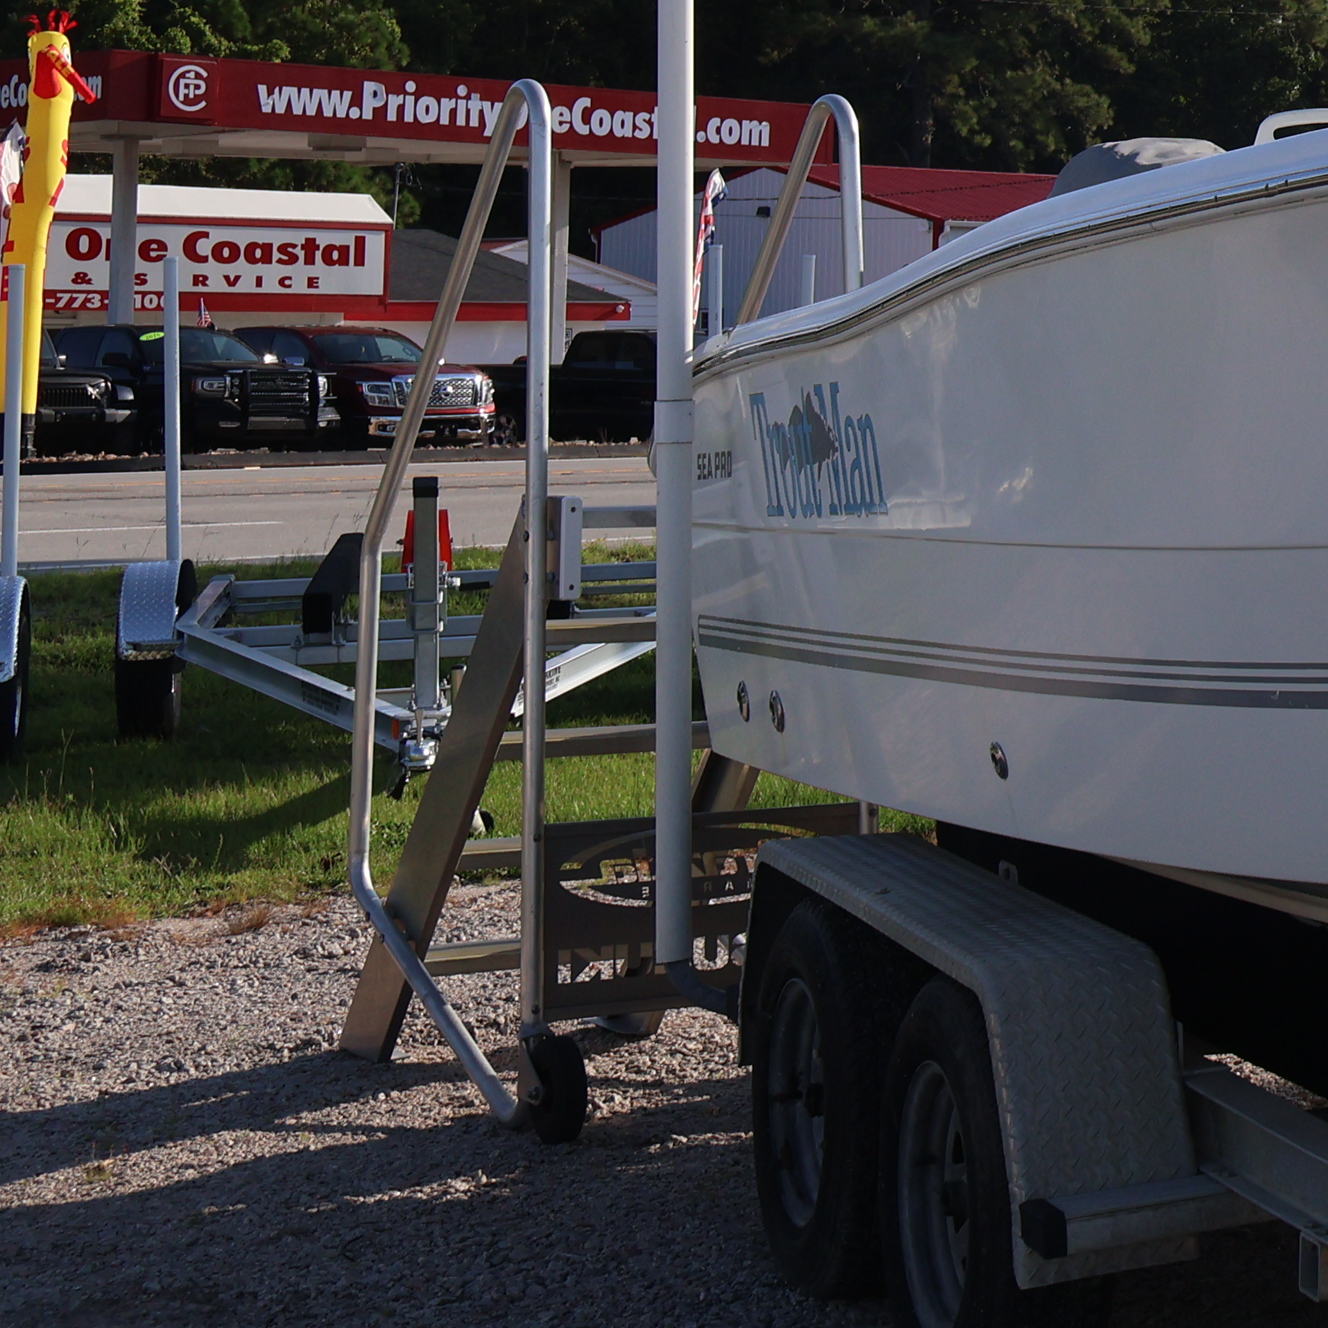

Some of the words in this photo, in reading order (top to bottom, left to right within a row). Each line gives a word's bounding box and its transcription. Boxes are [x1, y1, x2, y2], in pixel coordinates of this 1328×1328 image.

[65, 227, 168, 263] Oe
[182, 231, 366, 267] Coastal
[71, 272, 93, 286] &
[133, 272, 320, 289] SRVICE
[697, 452, 713, 481] SEA
[714, 450, 733, 478] PRO
